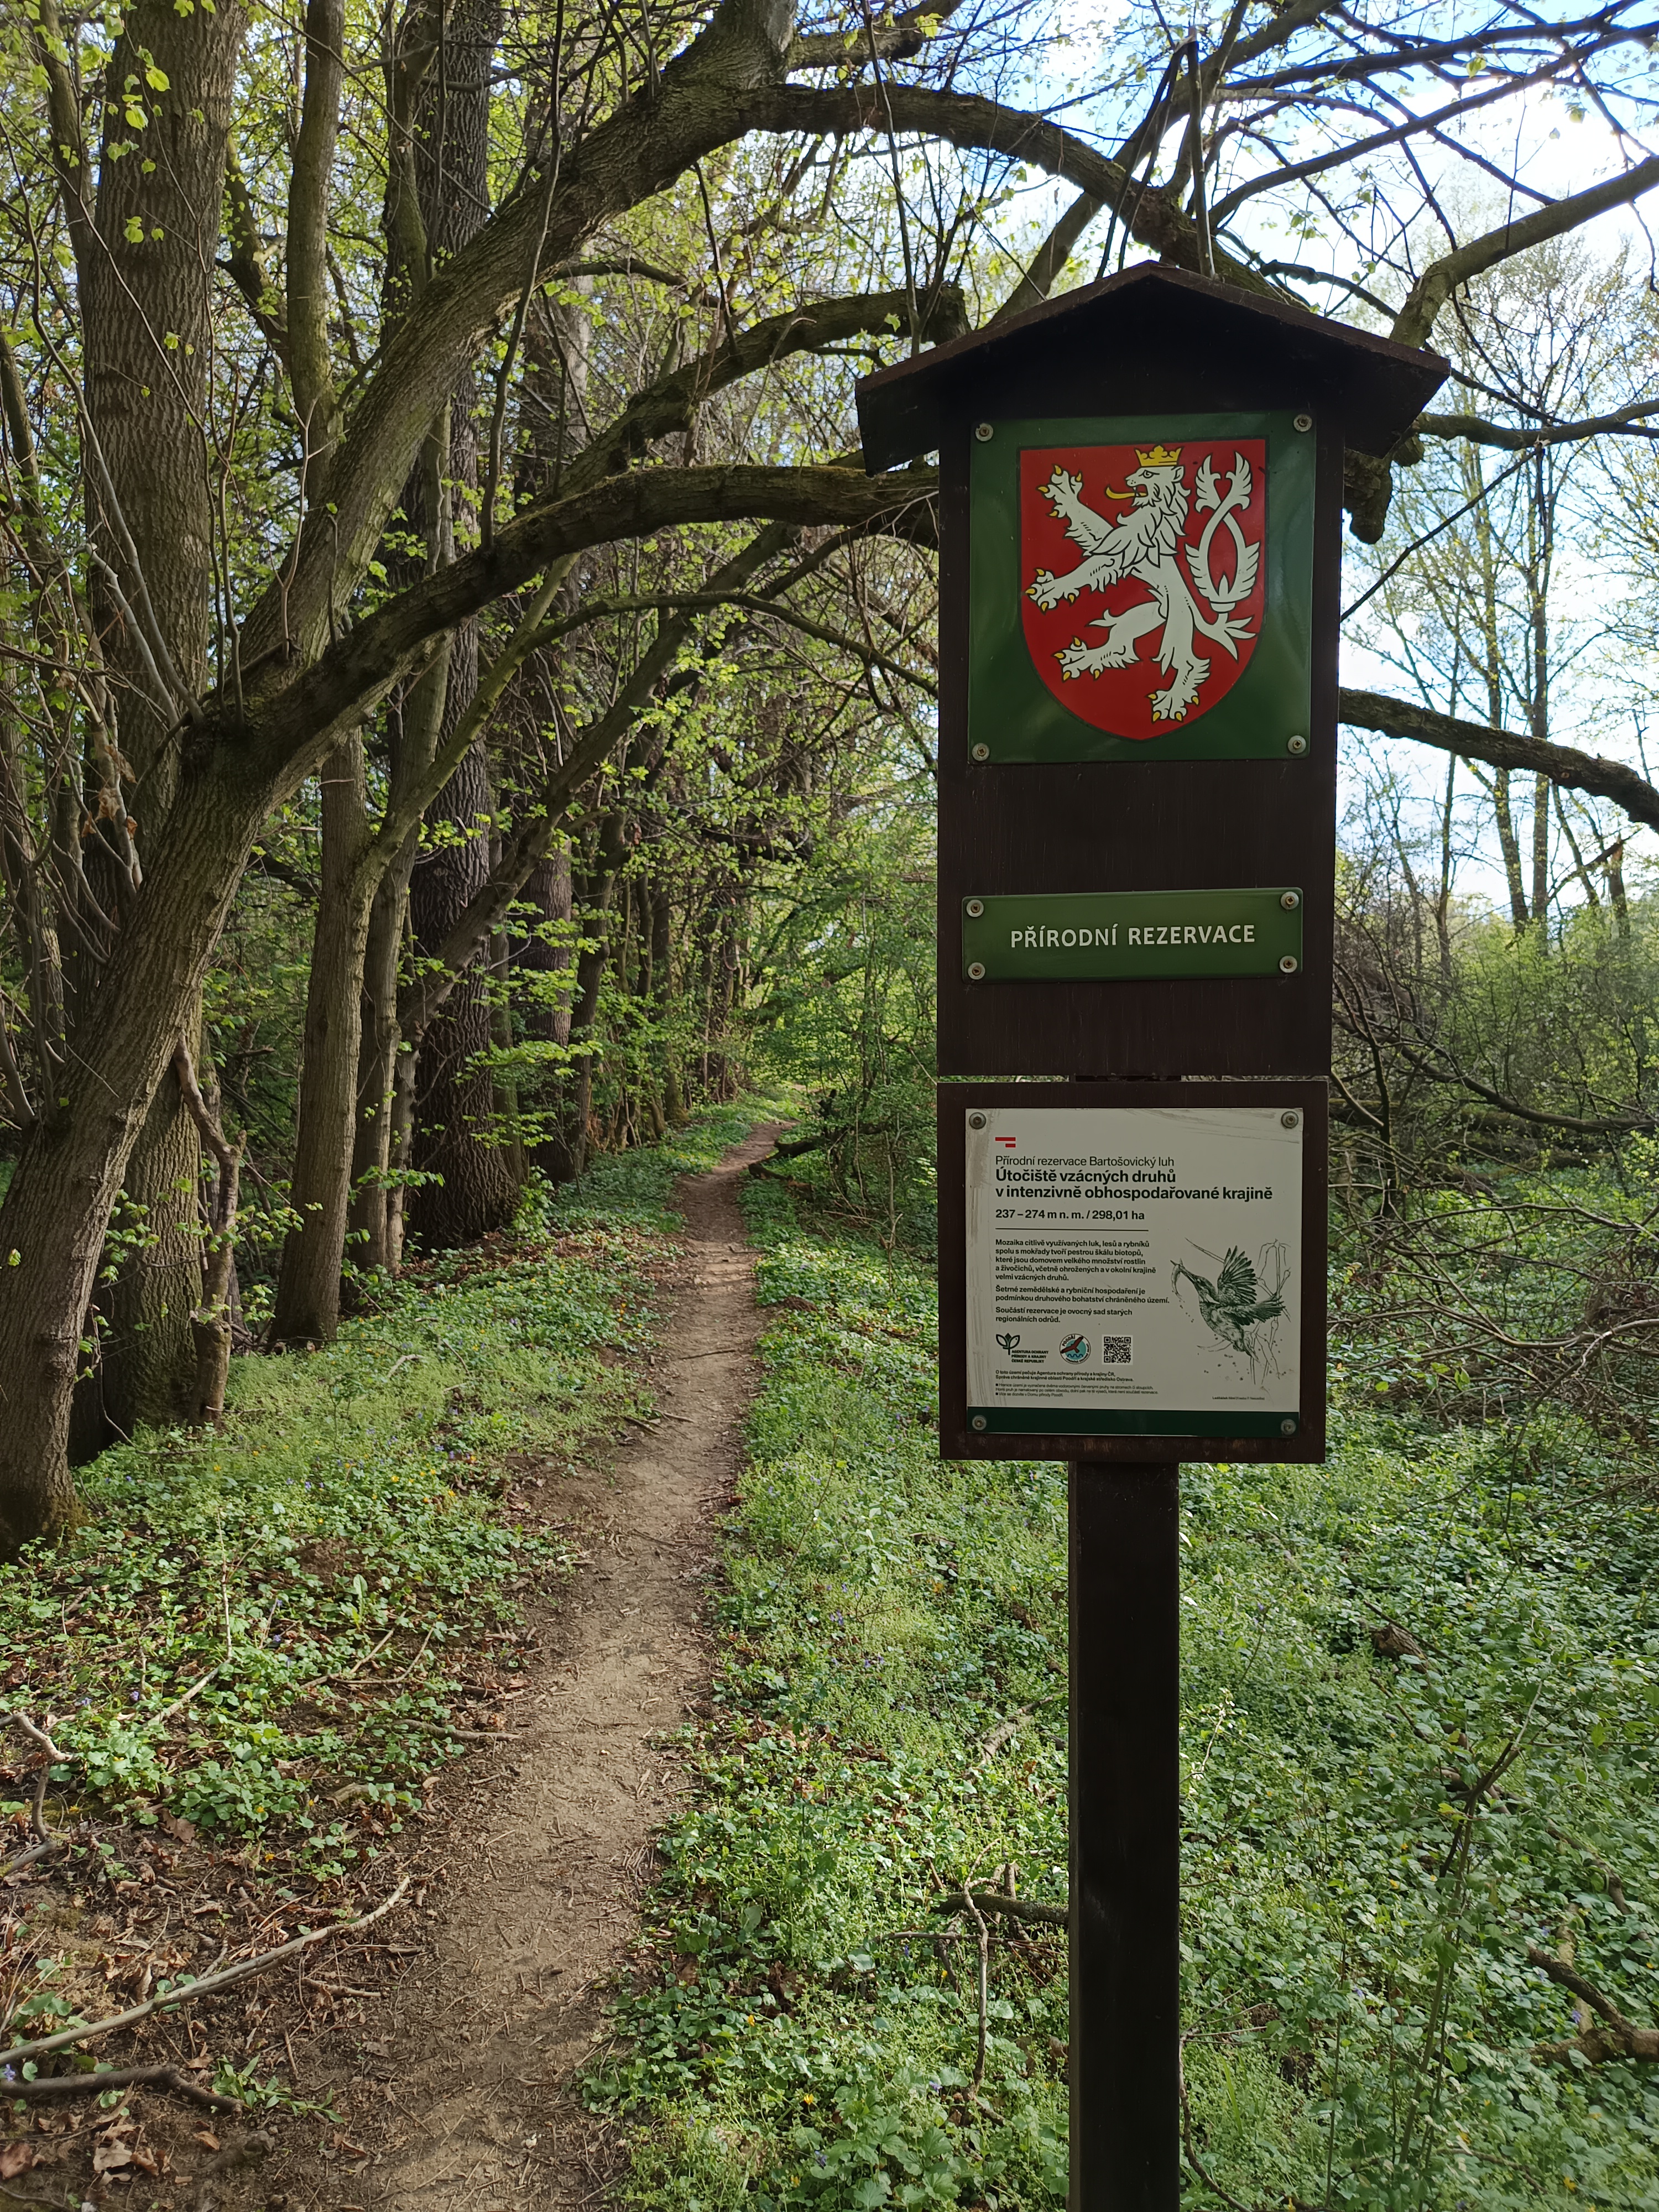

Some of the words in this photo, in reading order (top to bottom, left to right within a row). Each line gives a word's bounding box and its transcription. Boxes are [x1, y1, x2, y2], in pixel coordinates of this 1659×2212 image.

[1011, 924, 1118, 947] PŘÍRODNÍ
[1129, 925, 1254, 945] REZERVACE
[996, 1156, 1035, 1165] Přírodní
[1090, 1156, 1156, 1168] Bartošovický
[1159, 1157, 1174, 1166] luh
[997, 1166, 1057, 1181] Útočiště
[1060, 1170, 1128, 1185] vzácných
[1132, 1169, 1175, 1182] druhů
[995, 1188, 1004, 1197] v
[1007, 1185, 1081, 1198] intenzivně
[1085, 1186, 1219, 1201] obhospodařované
[1223, 1187, 1272, 1202] krajině
[996, 1209, 1015, 1218] 237
[1025, 1209, 1045, 1218] 274
[1087, 1211, 1090, 1219] /
[1092, 1211, 1128, 1221] 298,01
[1132, 1211, 1144, 1219] ha
